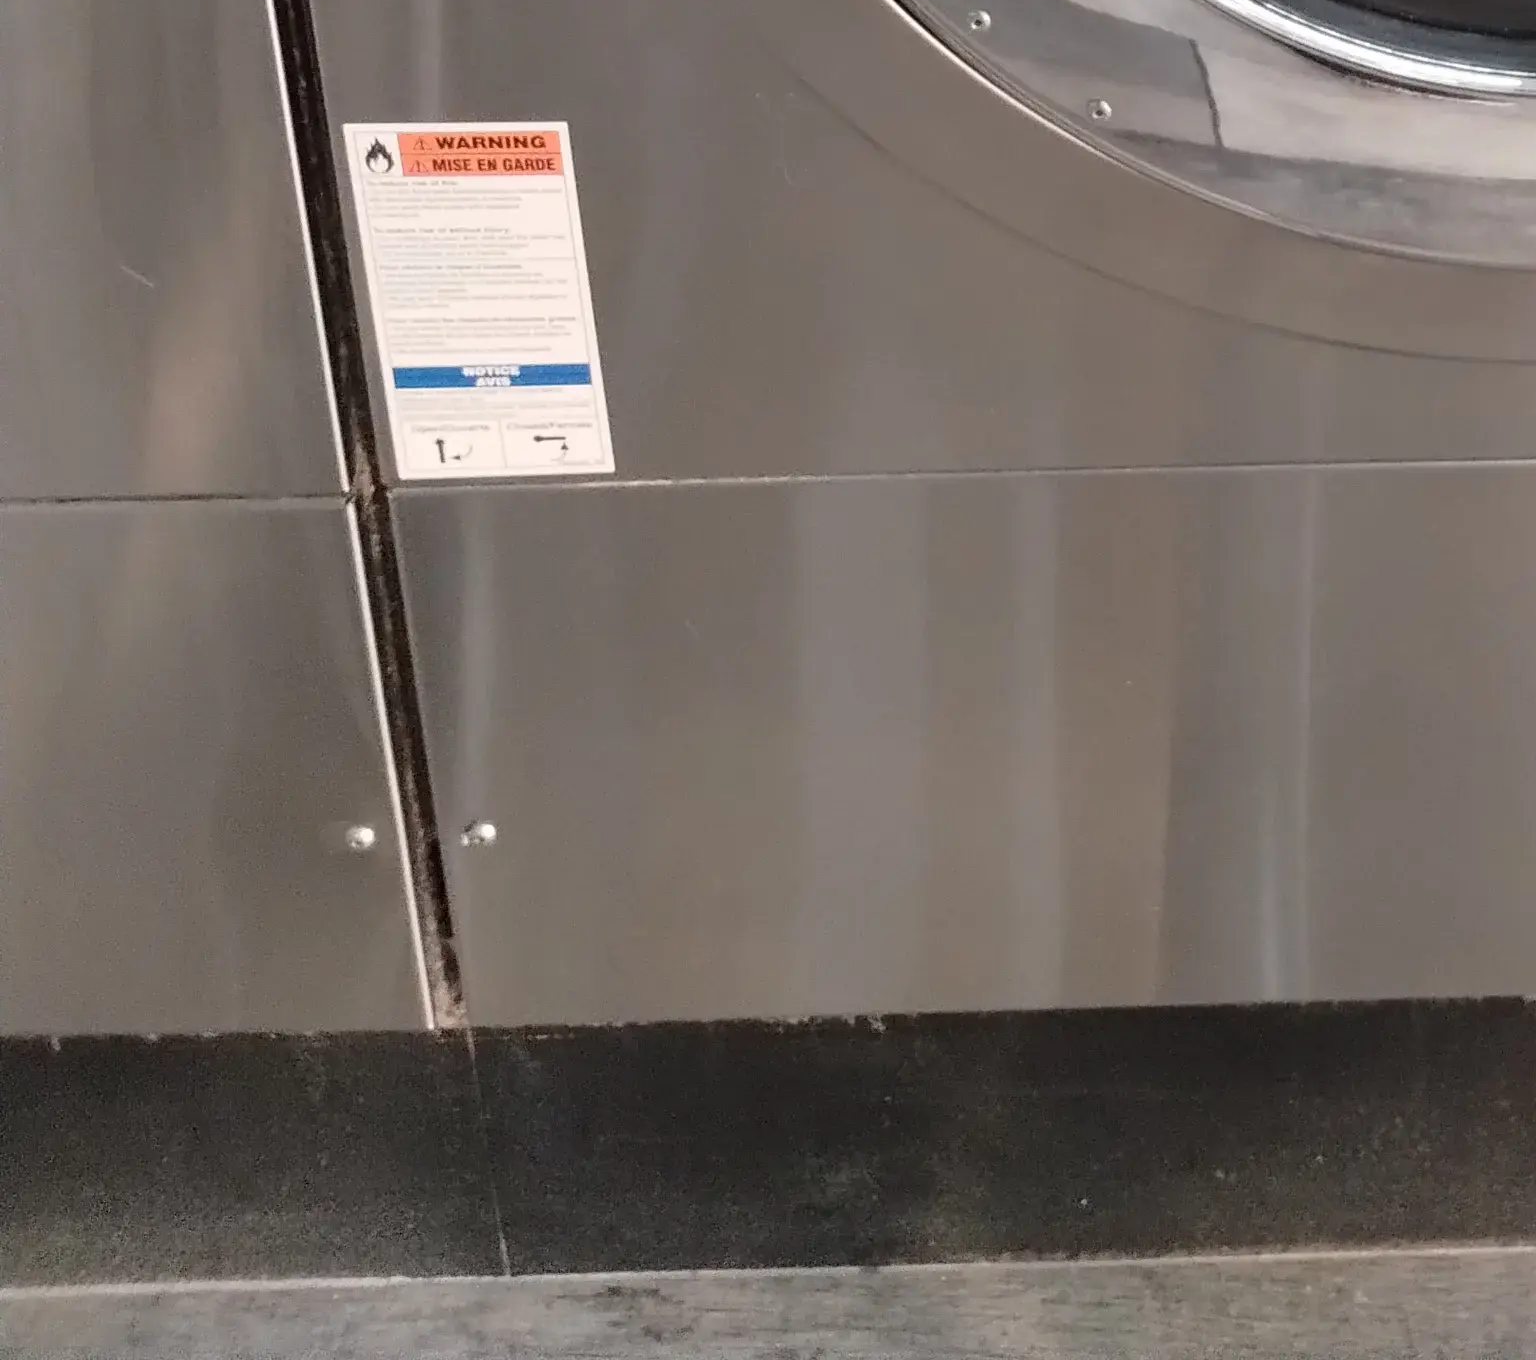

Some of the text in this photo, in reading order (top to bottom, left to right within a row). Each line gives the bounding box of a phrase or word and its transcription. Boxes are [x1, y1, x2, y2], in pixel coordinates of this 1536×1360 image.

[434, 134, 547, 150] WARNING
[432, 157, 556, 172] MISE EN GARDE
[461, 365, 521, 377] NOTICE
